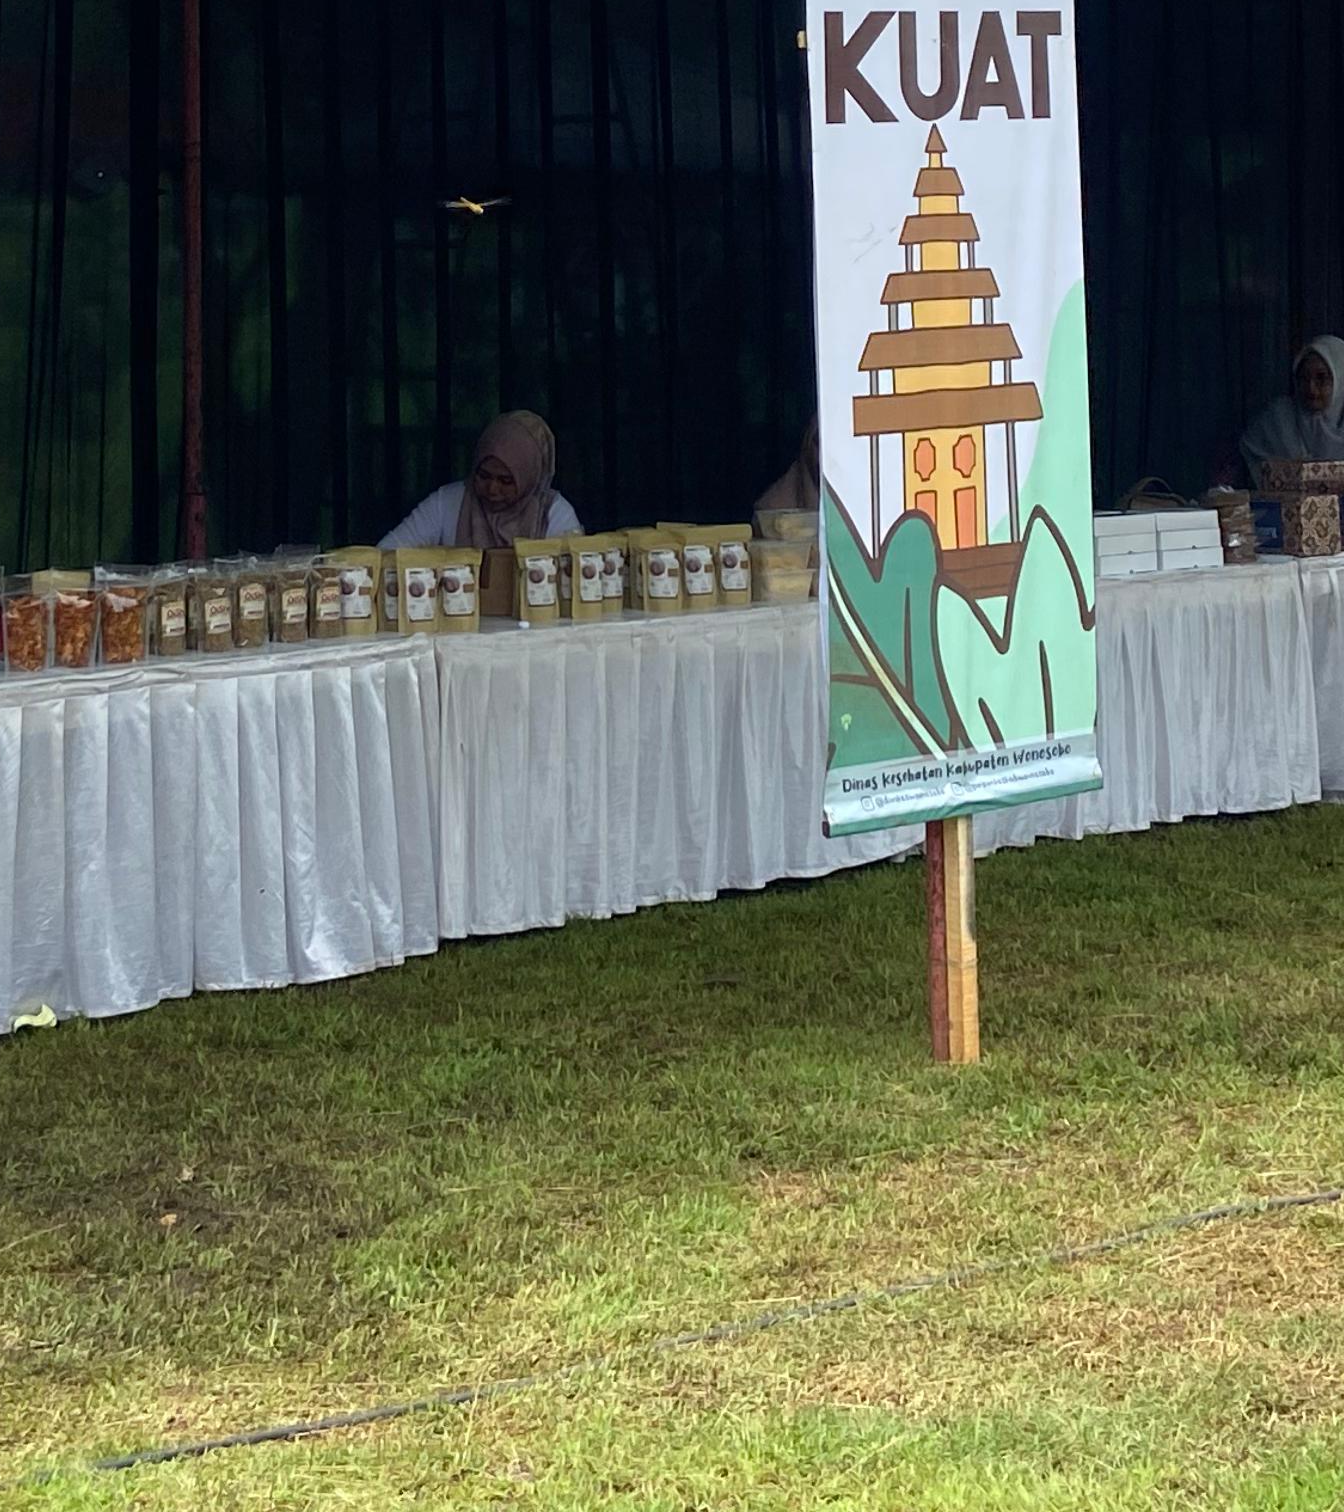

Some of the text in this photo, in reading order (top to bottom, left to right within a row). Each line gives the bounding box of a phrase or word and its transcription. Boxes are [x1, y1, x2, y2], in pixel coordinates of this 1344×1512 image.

[823, 10, 1062, 124] KUAT
[842, 777, 878, 793] Dinas
[1012, 743, 1071, 766] Wonosobo
